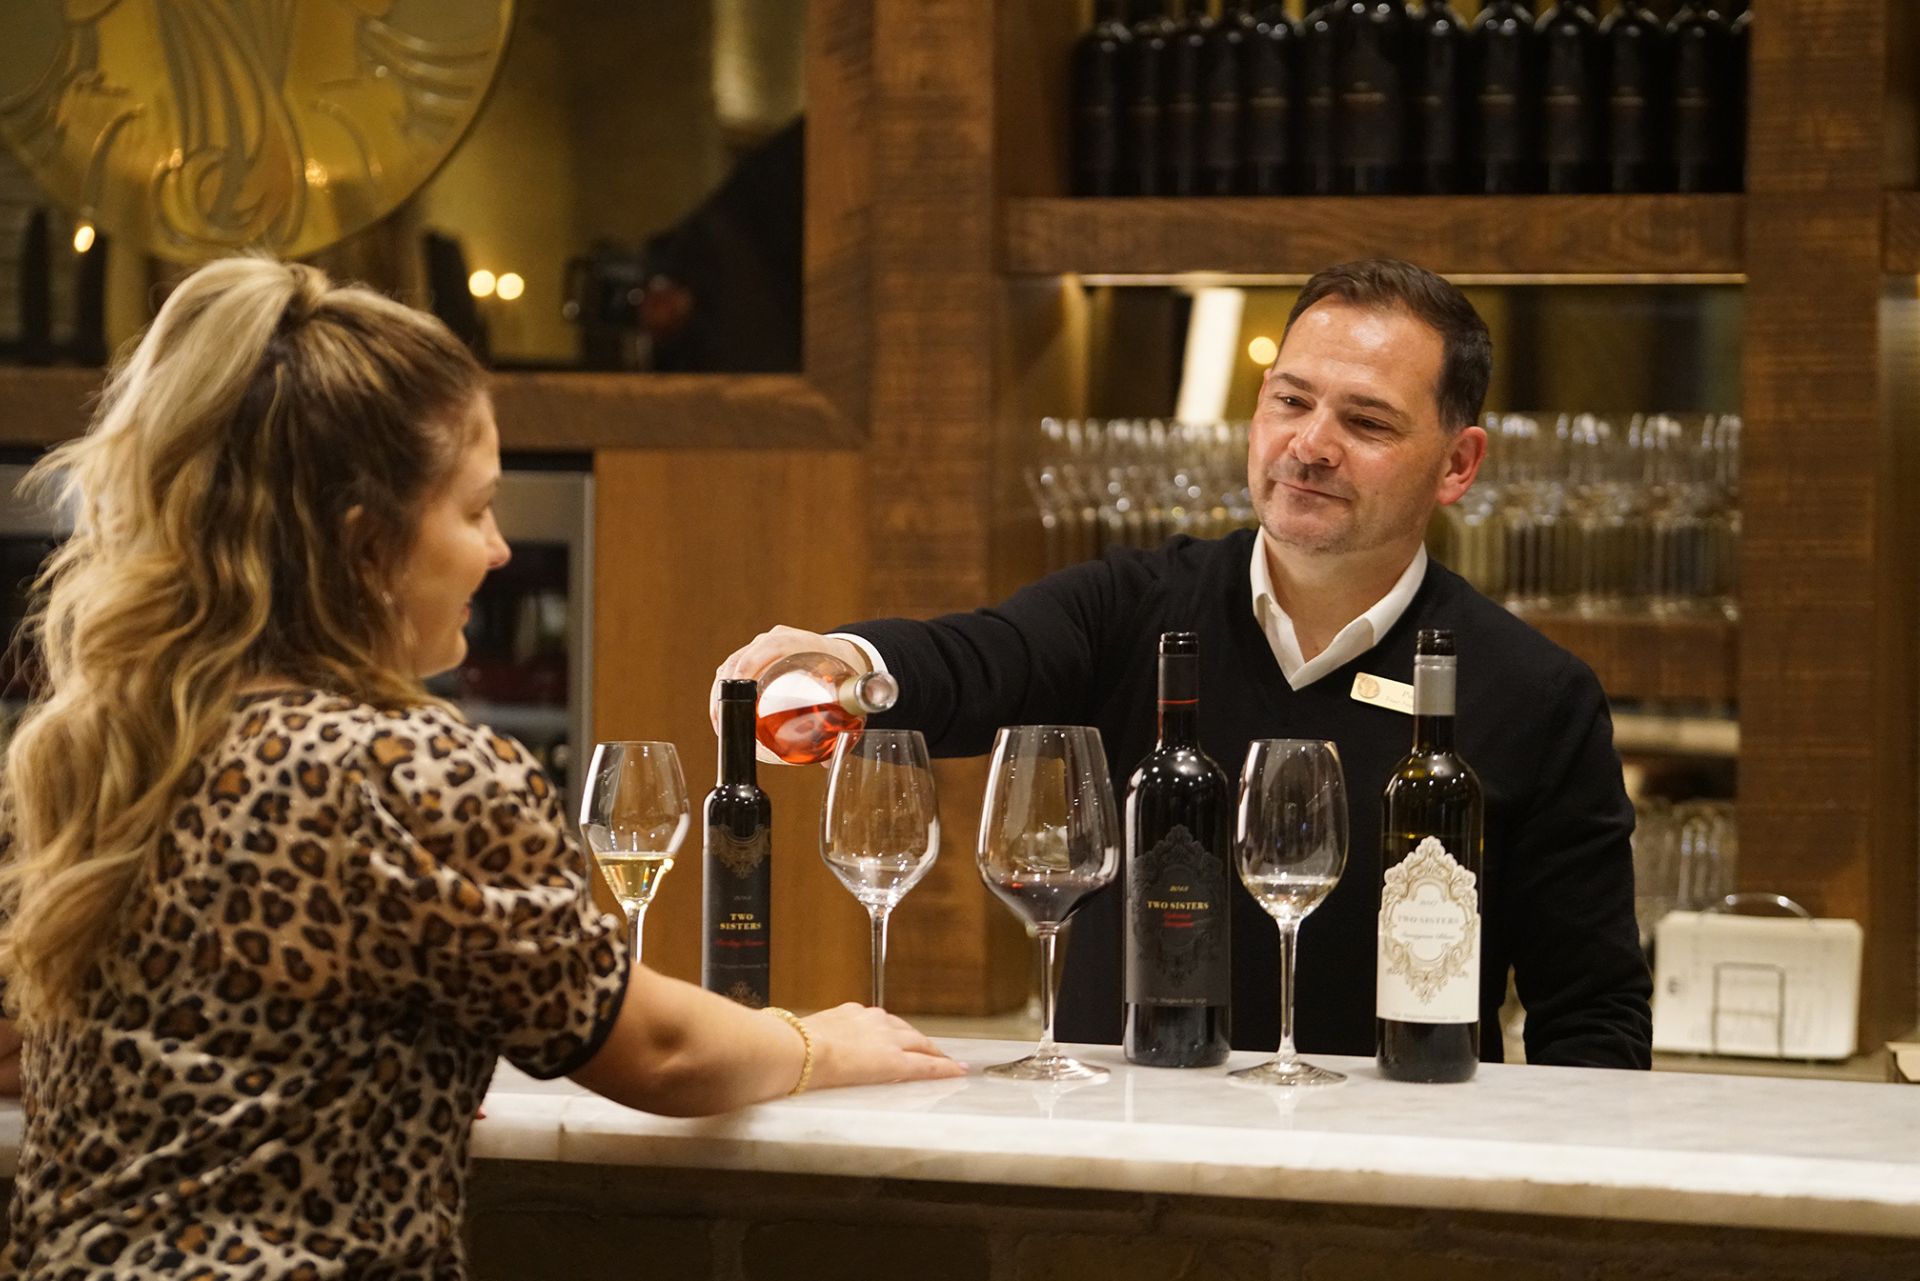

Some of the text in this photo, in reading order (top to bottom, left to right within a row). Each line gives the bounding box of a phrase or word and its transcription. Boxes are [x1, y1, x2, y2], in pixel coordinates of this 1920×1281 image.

[1147, 900, 1209, 910] TWO SISTERS
[729, 912, 754, 921] TWO
[719, 922, 762, 930] SISTERS
